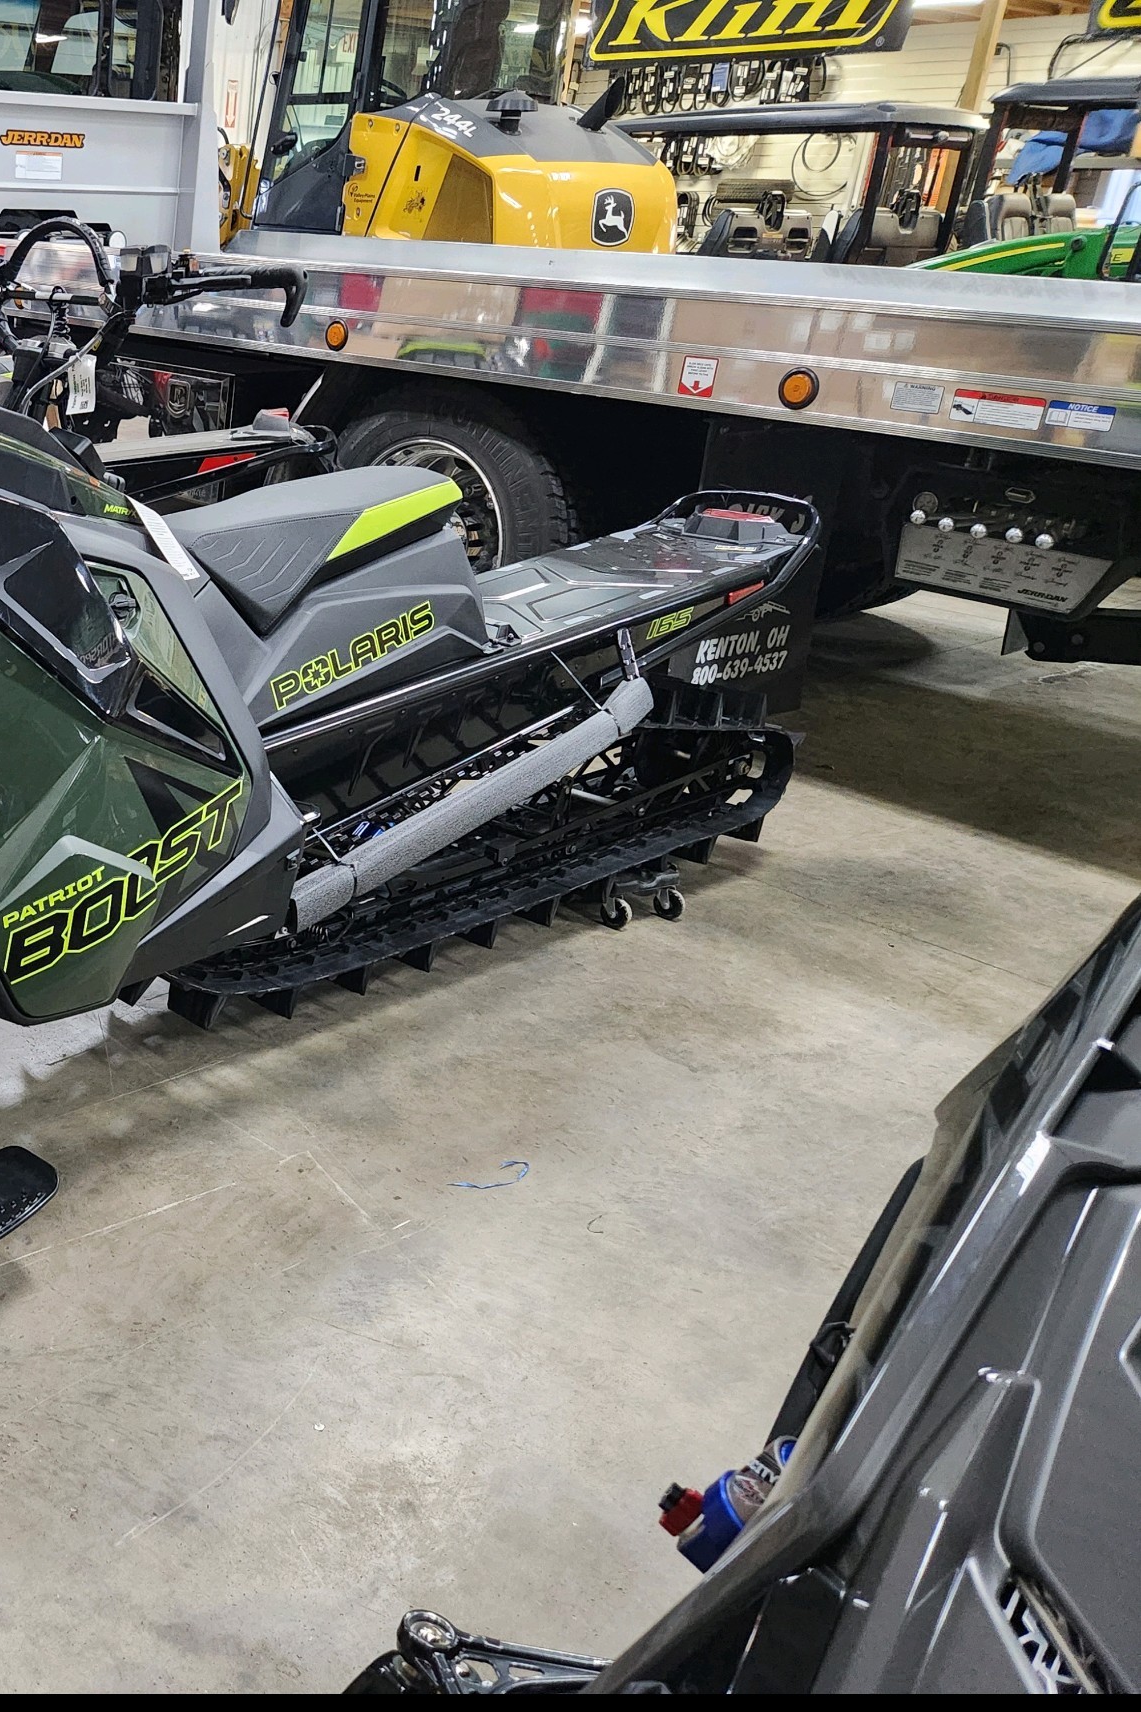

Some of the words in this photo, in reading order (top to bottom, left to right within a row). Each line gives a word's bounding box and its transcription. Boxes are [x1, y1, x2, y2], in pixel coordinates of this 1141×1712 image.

[343, 33, 358, 54] EXI
[431, 107, 477, 138] 244L
[1068, 402, 1099, 413] NOTICE
[646, 606, 695, 641] 165
[270, 600, 435, 711] POLARIS
[695, 630, 761, 664] KENTON,
[766, 624, 791, 650] OH
[690, 650, 789, 686] 800-639-4537
[2, 865, 106, 929] PATRIOT
[4, 779, 244, 986] BOOST
